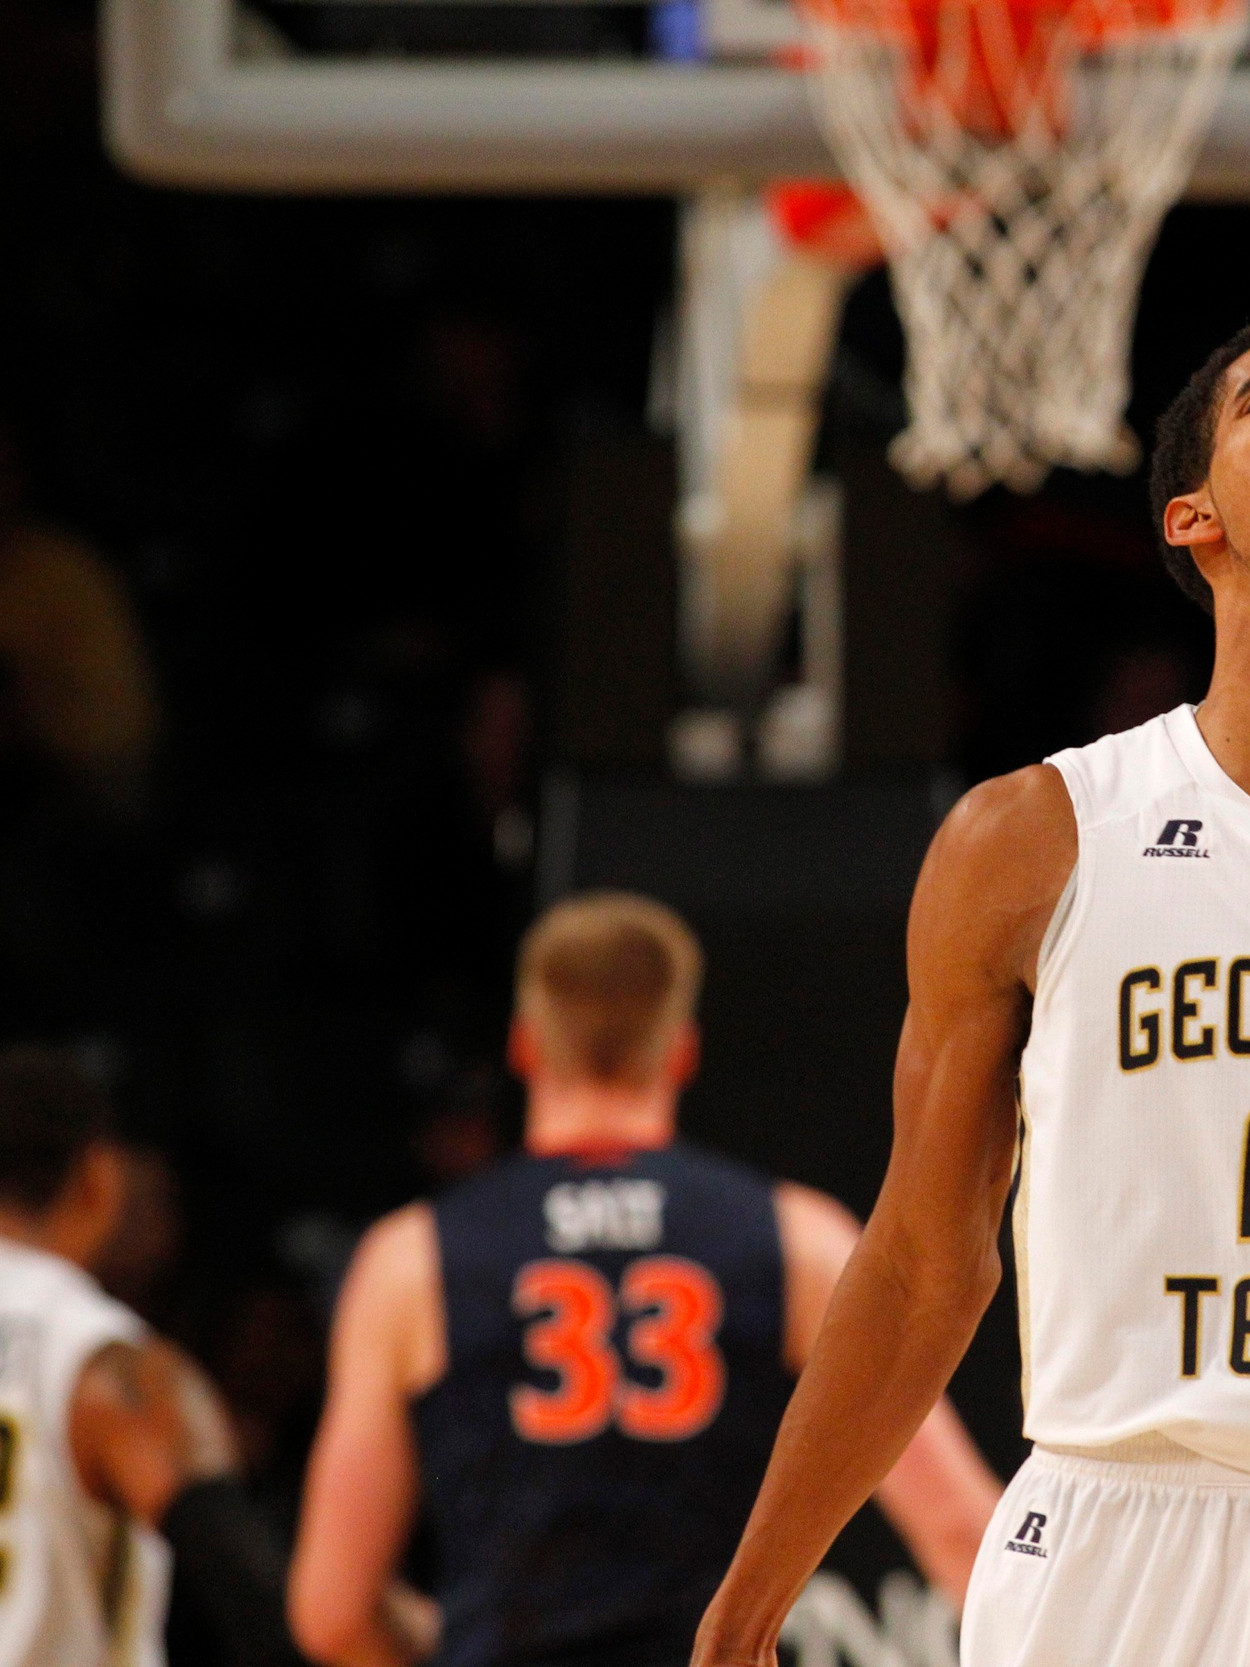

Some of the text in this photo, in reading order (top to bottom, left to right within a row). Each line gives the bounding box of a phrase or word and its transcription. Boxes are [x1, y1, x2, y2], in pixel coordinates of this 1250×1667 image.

[1142, 847, 1210, 858] RUSSELL
[509, 1256, 727, 1446] 33
[1004, 1541, 1048, 1558] RUSSELL
